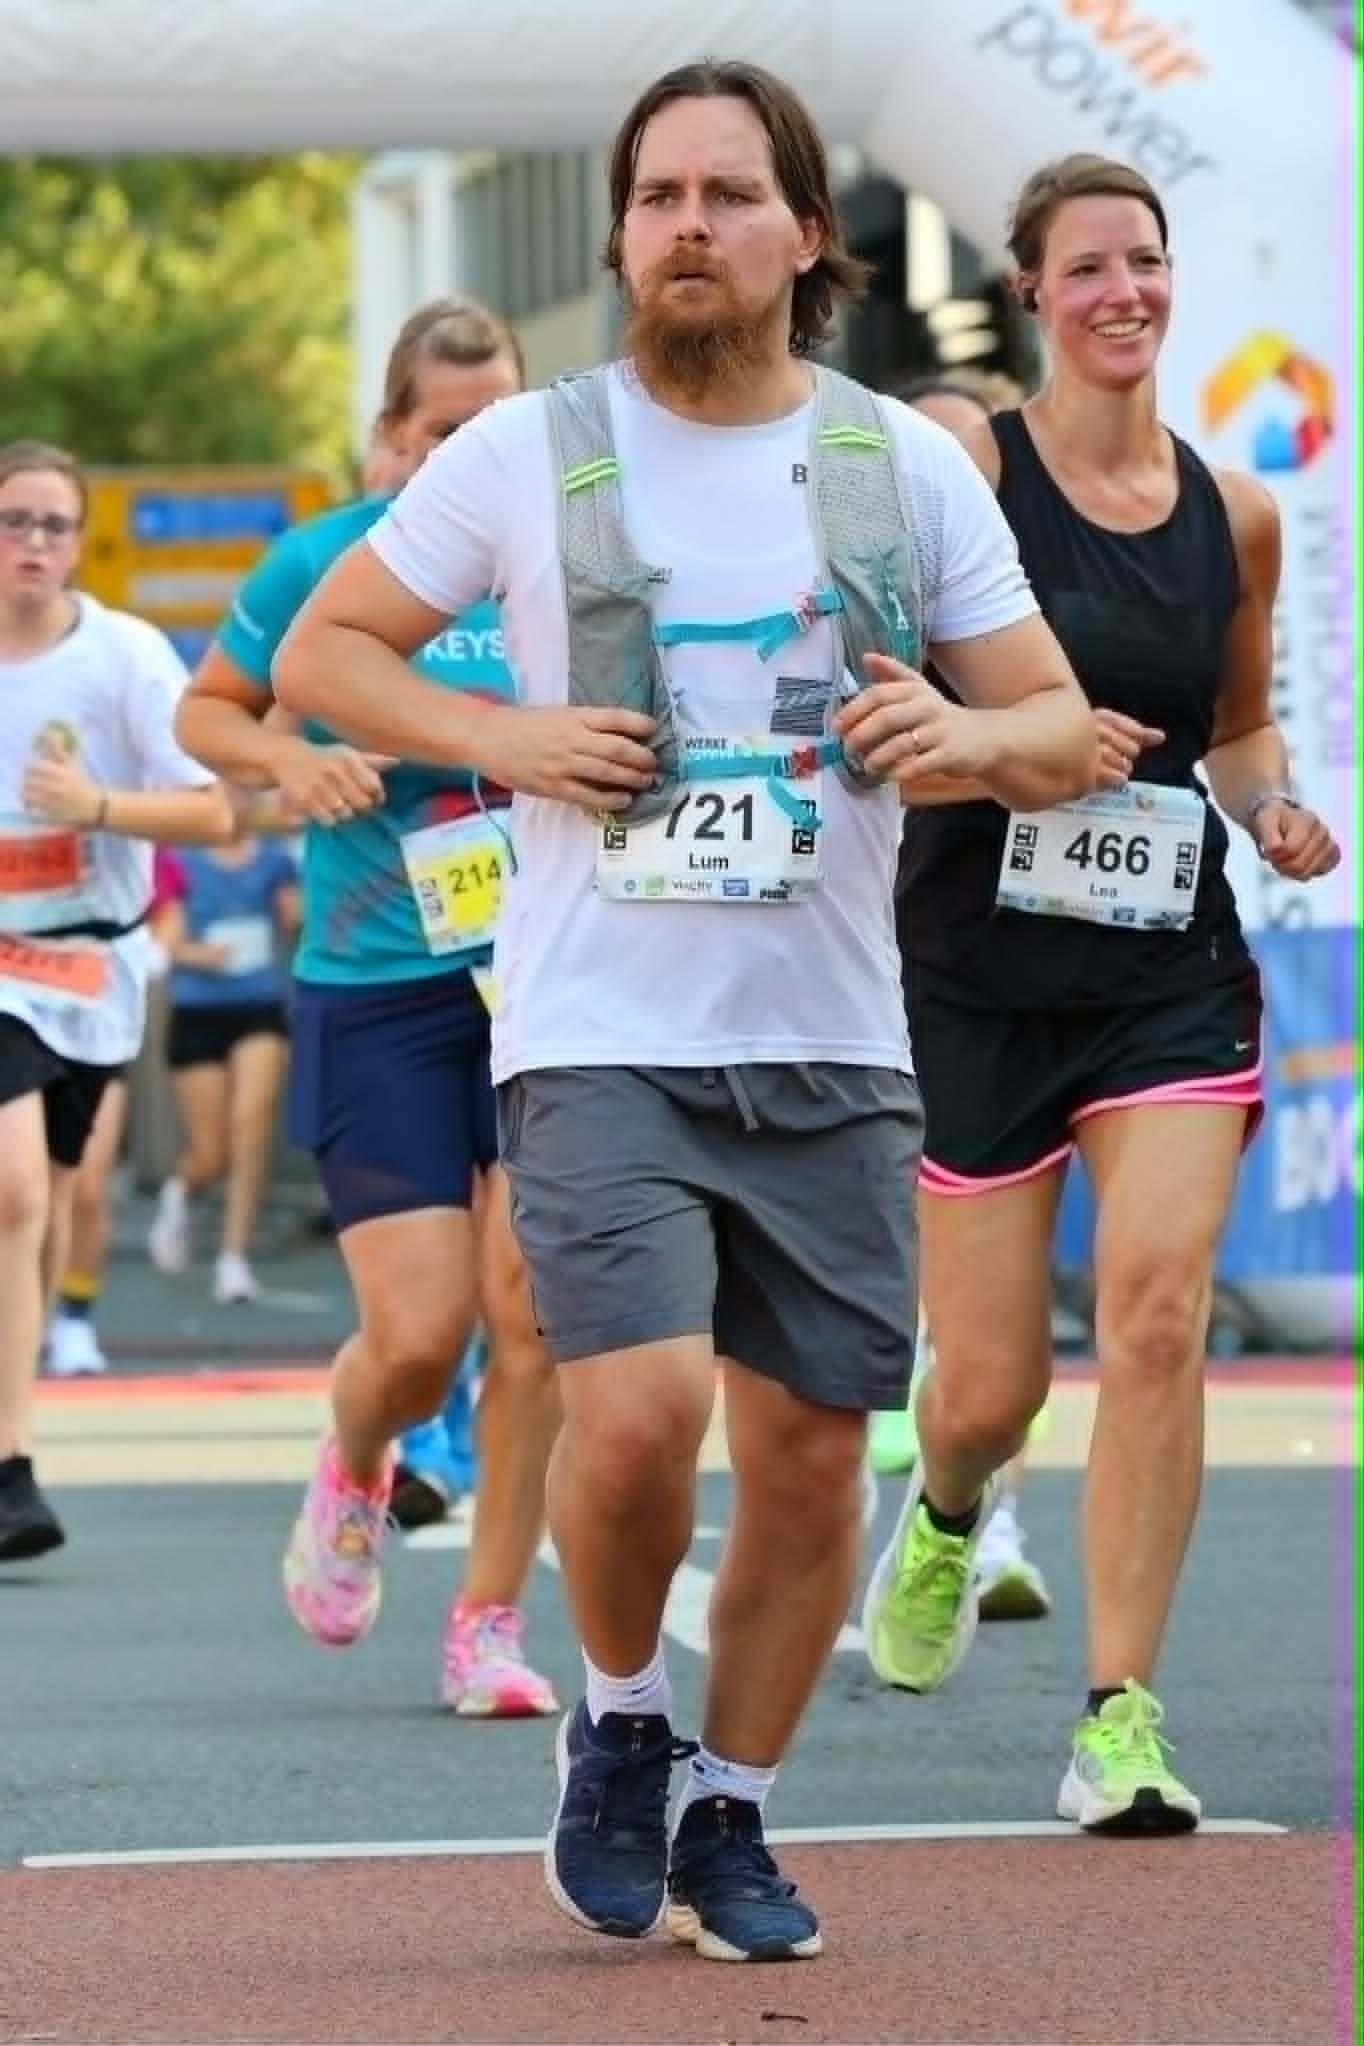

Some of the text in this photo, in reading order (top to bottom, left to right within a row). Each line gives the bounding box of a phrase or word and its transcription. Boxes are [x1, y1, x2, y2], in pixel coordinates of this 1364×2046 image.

[975, 4, 1217, 186] power
[688, 852, 729, 870] Lum
[1064, 828, 1152, 875] 466
